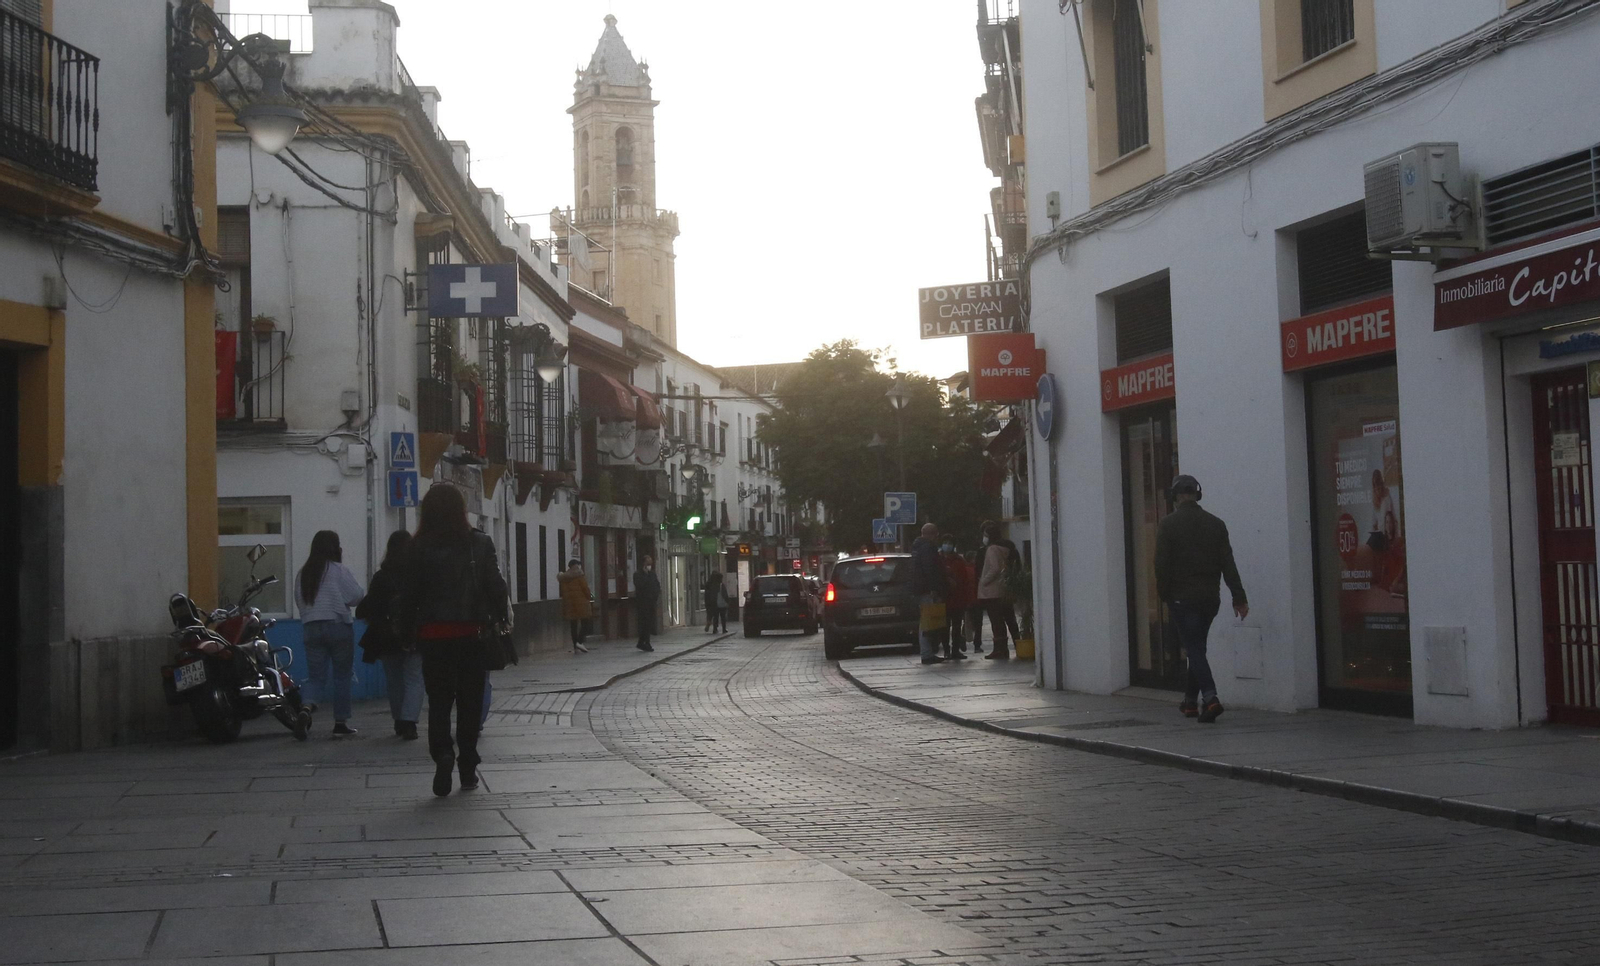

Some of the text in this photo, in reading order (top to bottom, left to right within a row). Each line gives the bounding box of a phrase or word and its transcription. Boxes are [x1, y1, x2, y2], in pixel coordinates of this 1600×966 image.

[1440, 248, 1600, 307] Inmobiliaría Capit
[922, 282, 1018, 303] JOYERIA
[939, 300, 1003, 318] CARYAN
[1306, 309, 1391, 354] MAPFRE
[980, 367, 1031, 378] MAPFRE
[1117, 362, 1174, 398] MAPFRE
[1364, 425, 1383, 433] MAPFRE
[1336, 475, 1362, 490] SIEMPRE
[886, 497, 902, 518] P
[1337, 490, 1372, 506] DISPONIBLE
